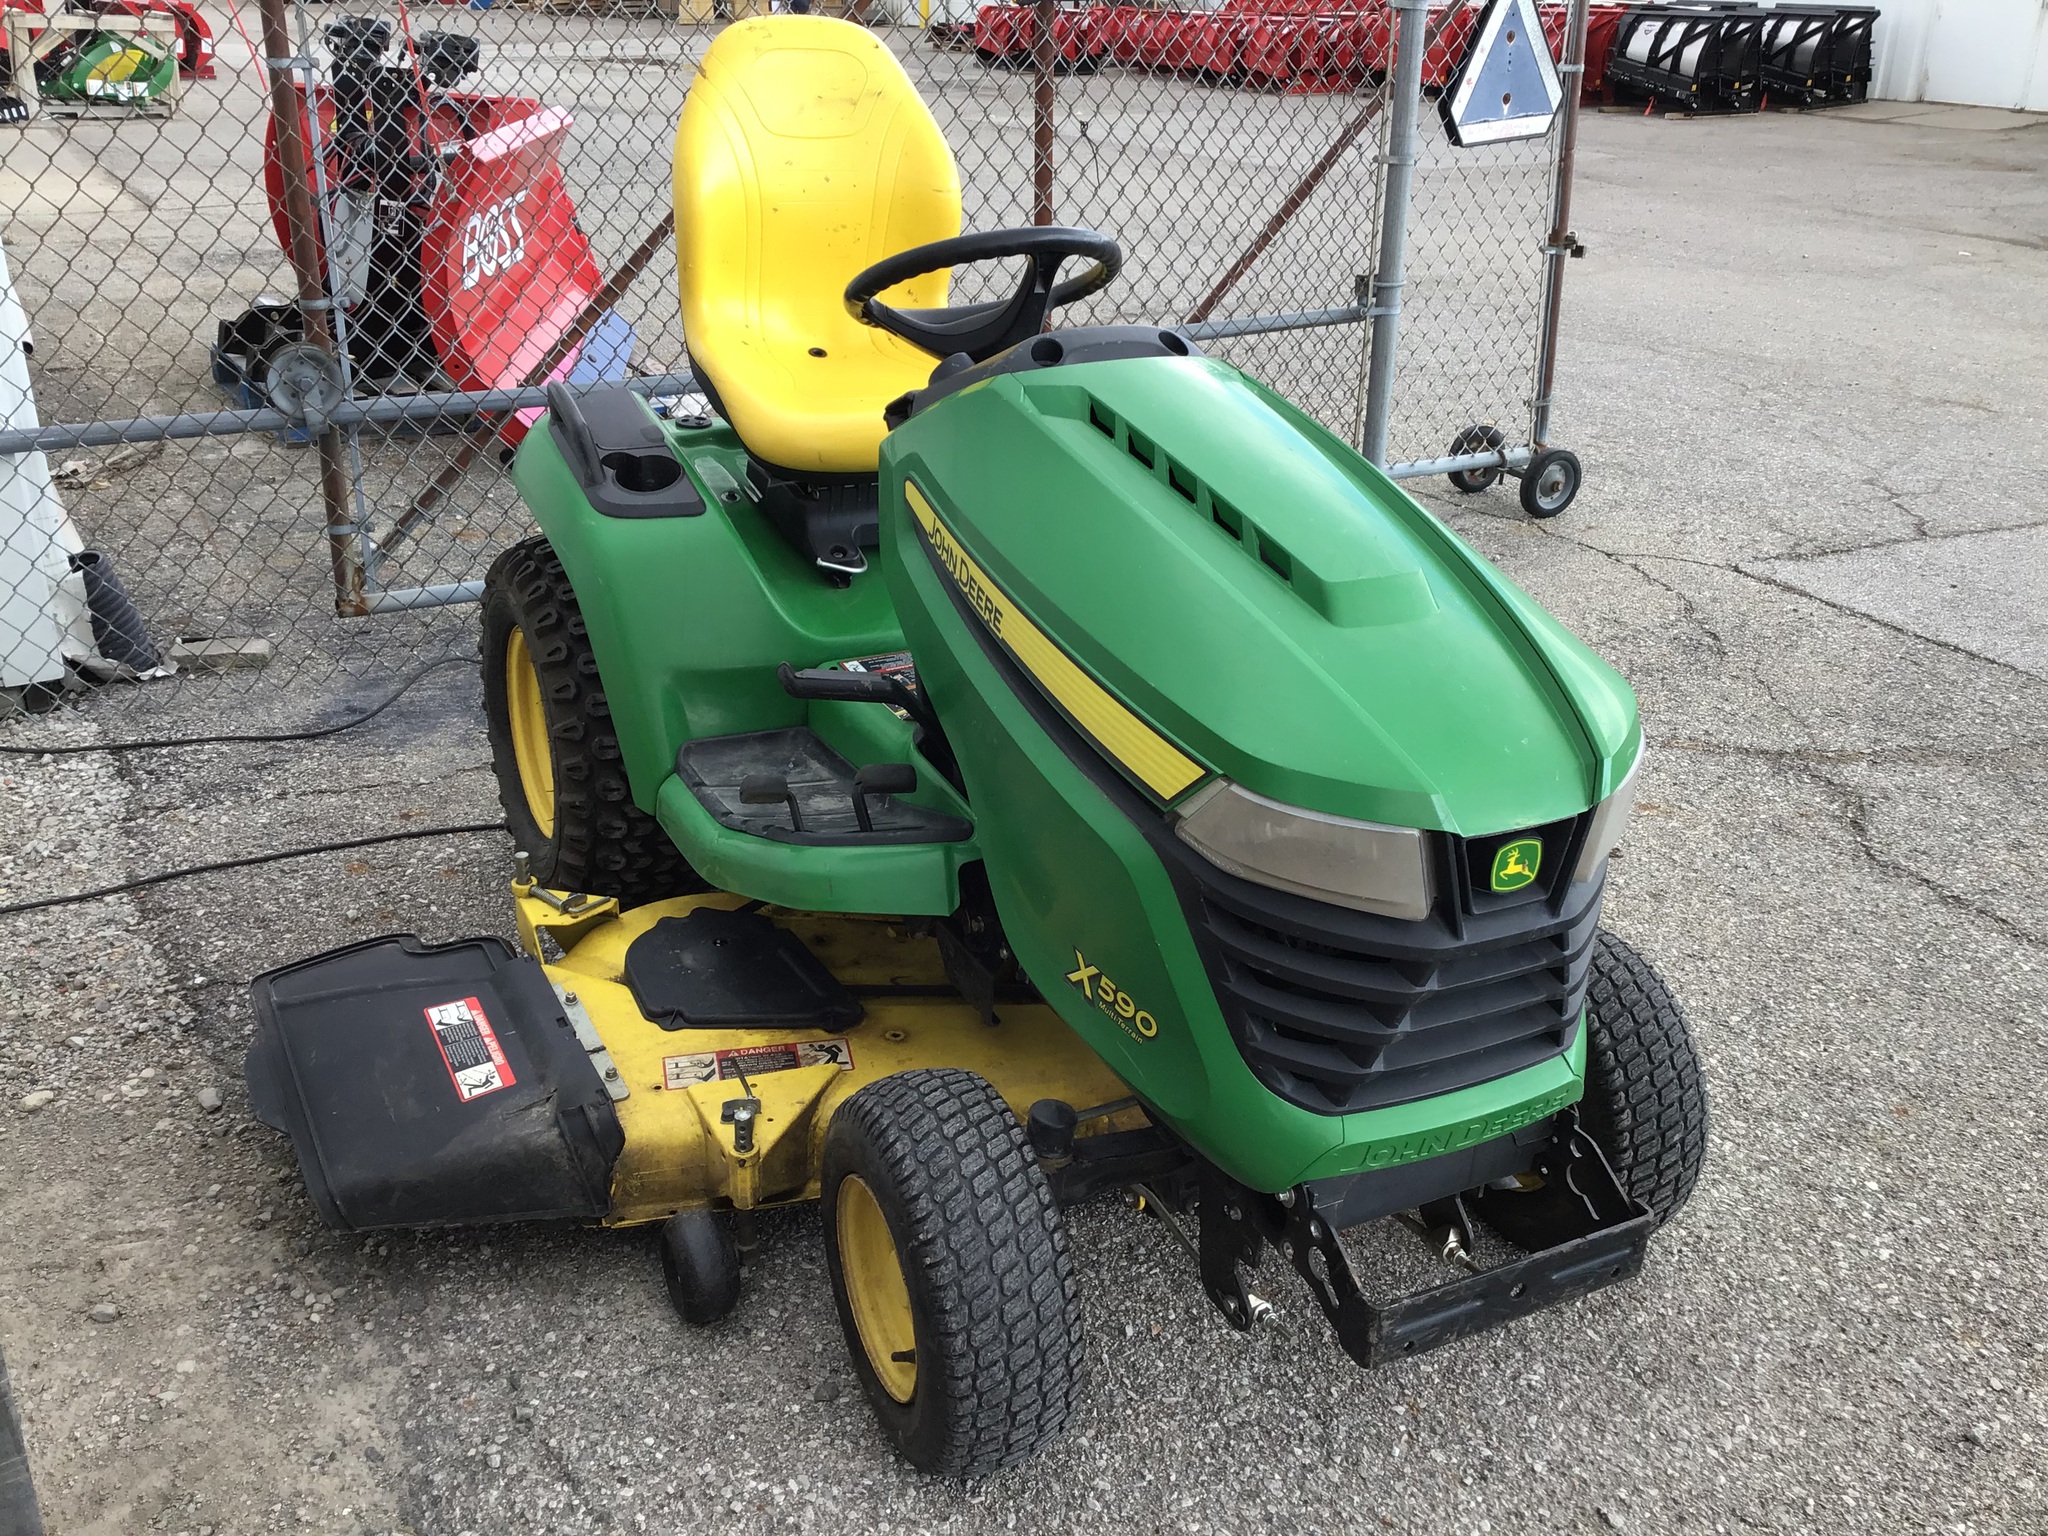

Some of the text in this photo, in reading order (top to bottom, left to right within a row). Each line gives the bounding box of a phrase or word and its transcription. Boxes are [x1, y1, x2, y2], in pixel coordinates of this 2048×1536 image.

[463, 189, 528, 290] BOSS
[928, 517, 1004, 633] JOHN DEERE
[1066, 948, 1158, 1038] X590
[474, 1015, 504, 1066] DANGER PELIGRO
[740, 1045, 786, 1056] DANGER
[1340, 1089, 1570, 1172] JOHN DEERE
